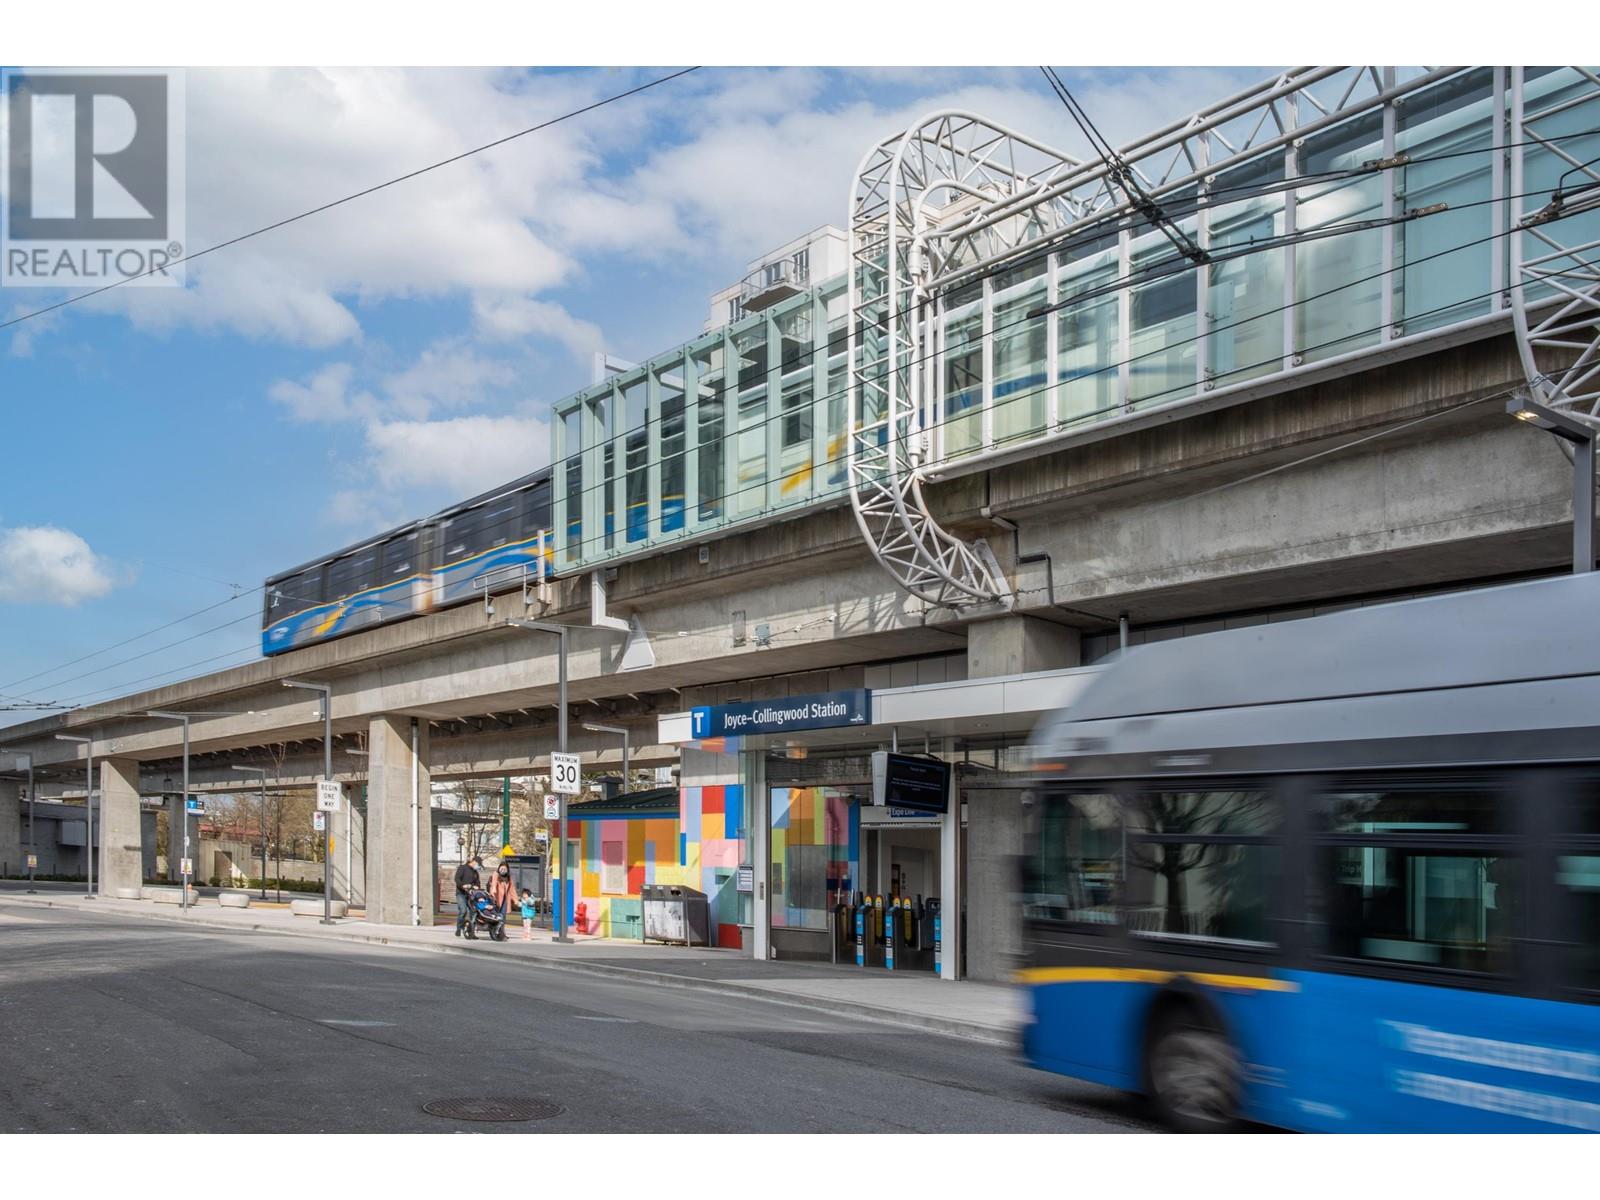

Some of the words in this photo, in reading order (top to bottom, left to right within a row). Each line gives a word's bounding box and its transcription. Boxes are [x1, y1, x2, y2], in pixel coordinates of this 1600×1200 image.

[694, 712, 704, 733] T
[811, 701, 847, 718] Station
[556, 764, 576, 783] 30
